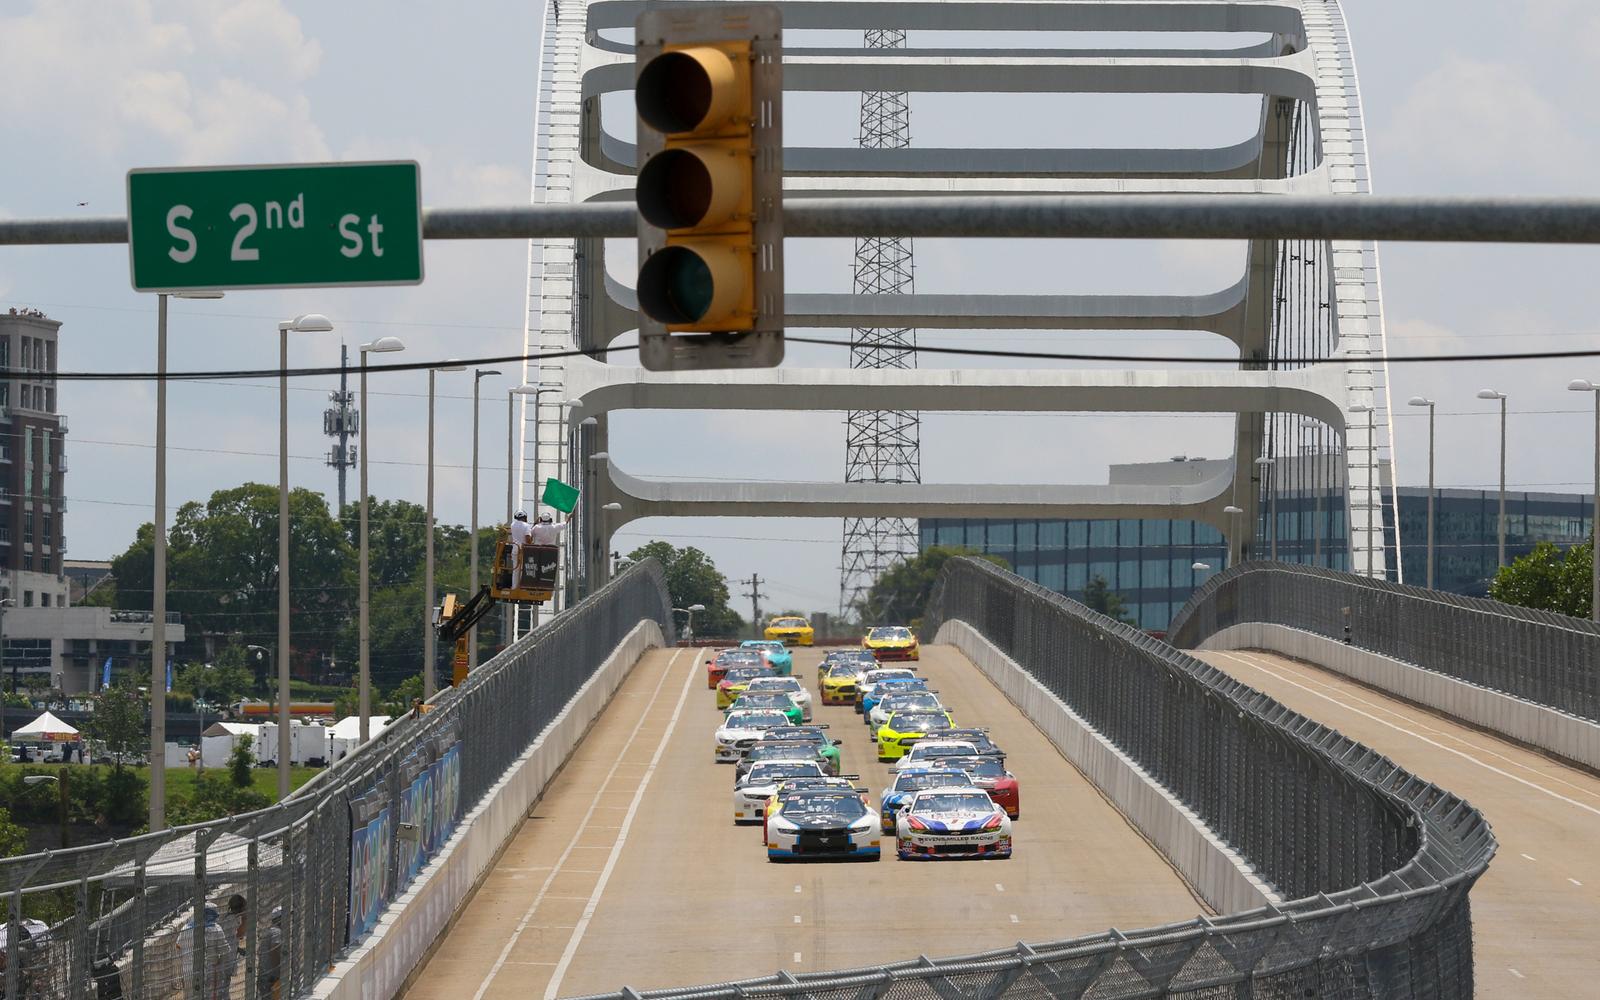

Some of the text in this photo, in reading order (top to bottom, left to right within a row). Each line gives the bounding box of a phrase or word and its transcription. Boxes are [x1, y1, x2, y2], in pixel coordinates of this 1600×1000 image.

[166, 192, 384, 263] S 2nd St
